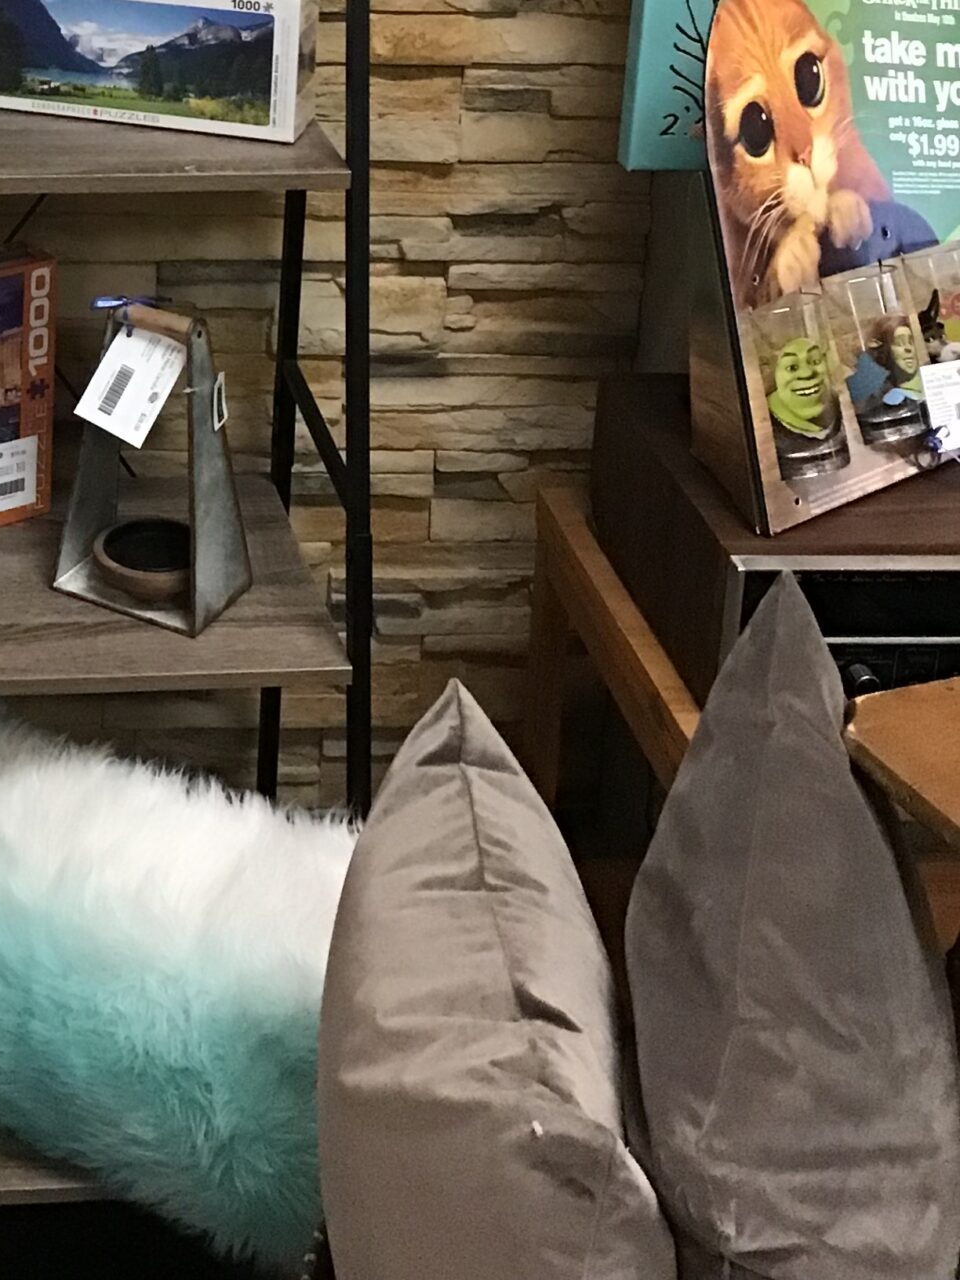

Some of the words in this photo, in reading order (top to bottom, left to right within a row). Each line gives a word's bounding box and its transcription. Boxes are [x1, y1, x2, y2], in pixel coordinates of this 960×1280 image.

[862, 29, 927, 67] take
[863, 69, 927, 104] with
[907, 131, 960, 158] $1.99
[28, 266, 52, 378] 1000
